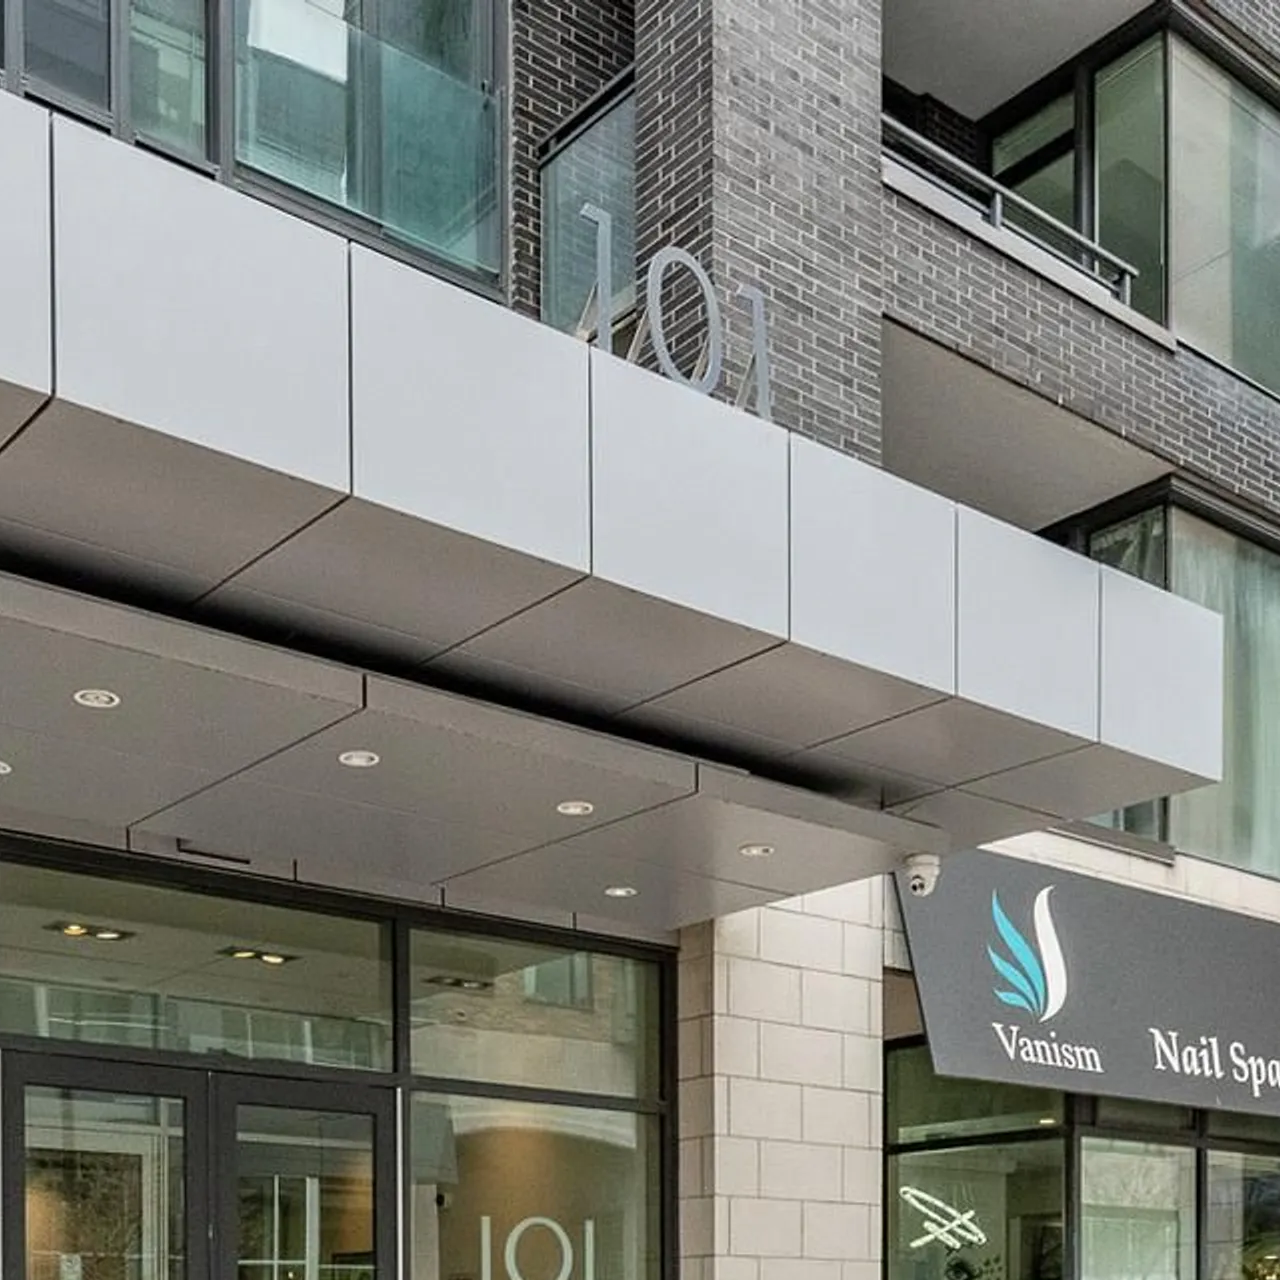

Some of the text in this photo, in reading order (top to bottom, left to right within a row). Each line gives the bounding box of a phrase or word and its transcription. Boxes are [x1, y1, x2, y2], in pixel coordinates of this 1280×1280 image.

[579, 201, 773, 422] 101
[991, 1022, 1104, 1073] Vanism
[1148, 1028, 1224, 1079] Nail
